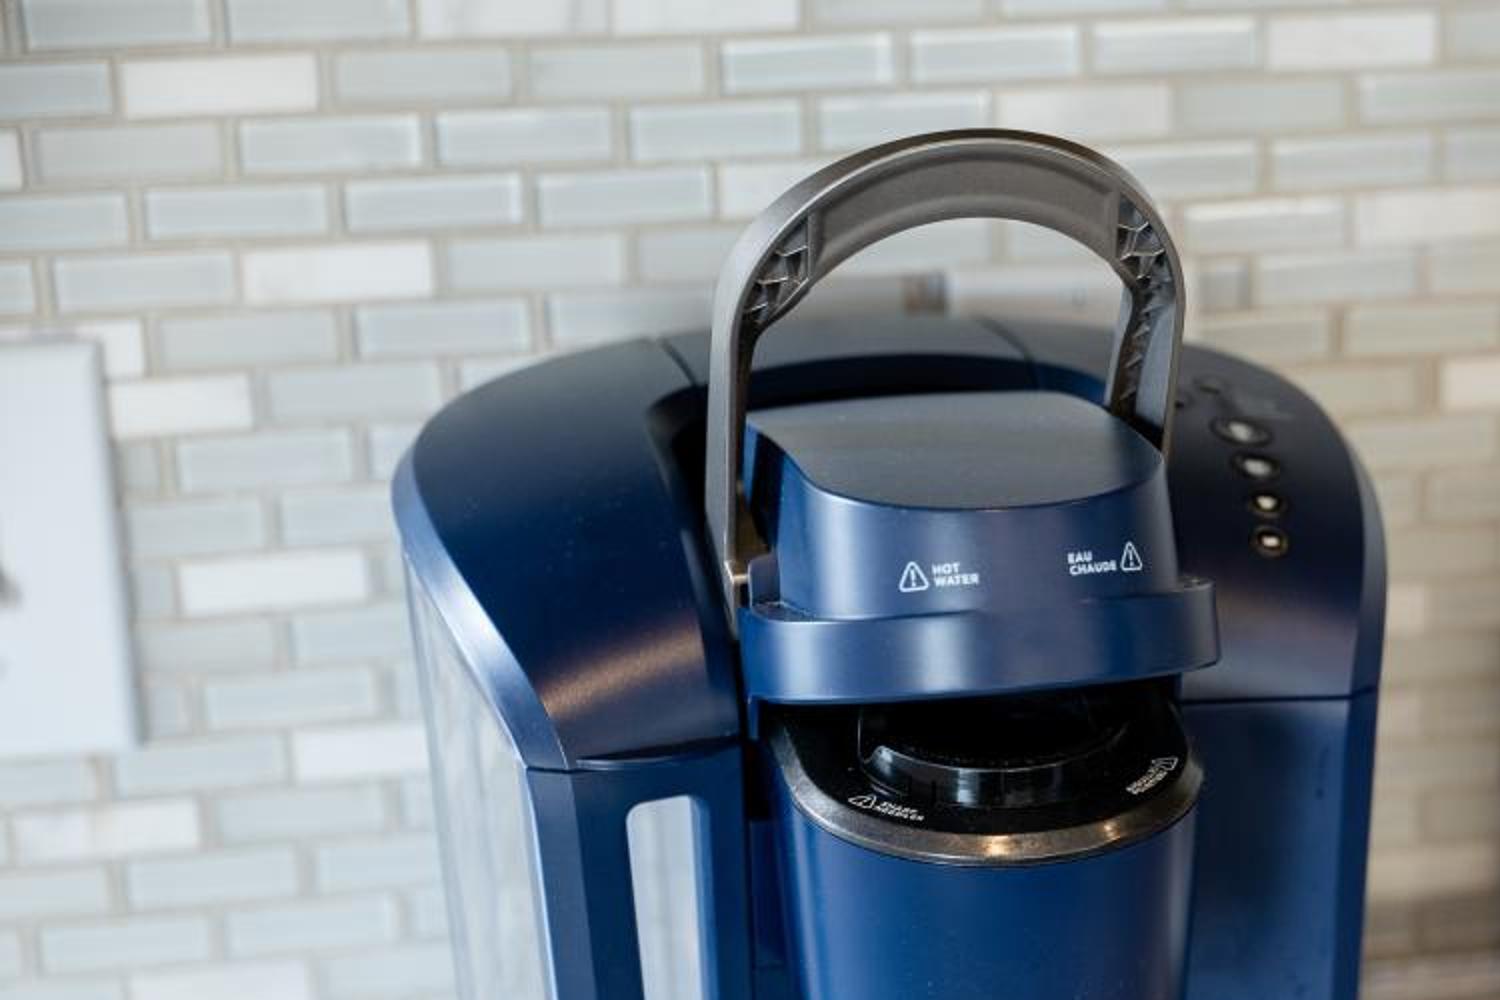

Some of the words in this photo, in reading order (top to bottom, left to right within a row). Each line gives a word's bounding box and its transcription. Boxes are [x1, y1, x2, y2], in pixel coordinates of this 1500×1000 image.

[1068, 551, 1092, 564] EAU
[932, 563, 960, 575] HOT
[1069, 560, 1117, 575] CHAUDE
[934, 573, 979, 587] WATER
